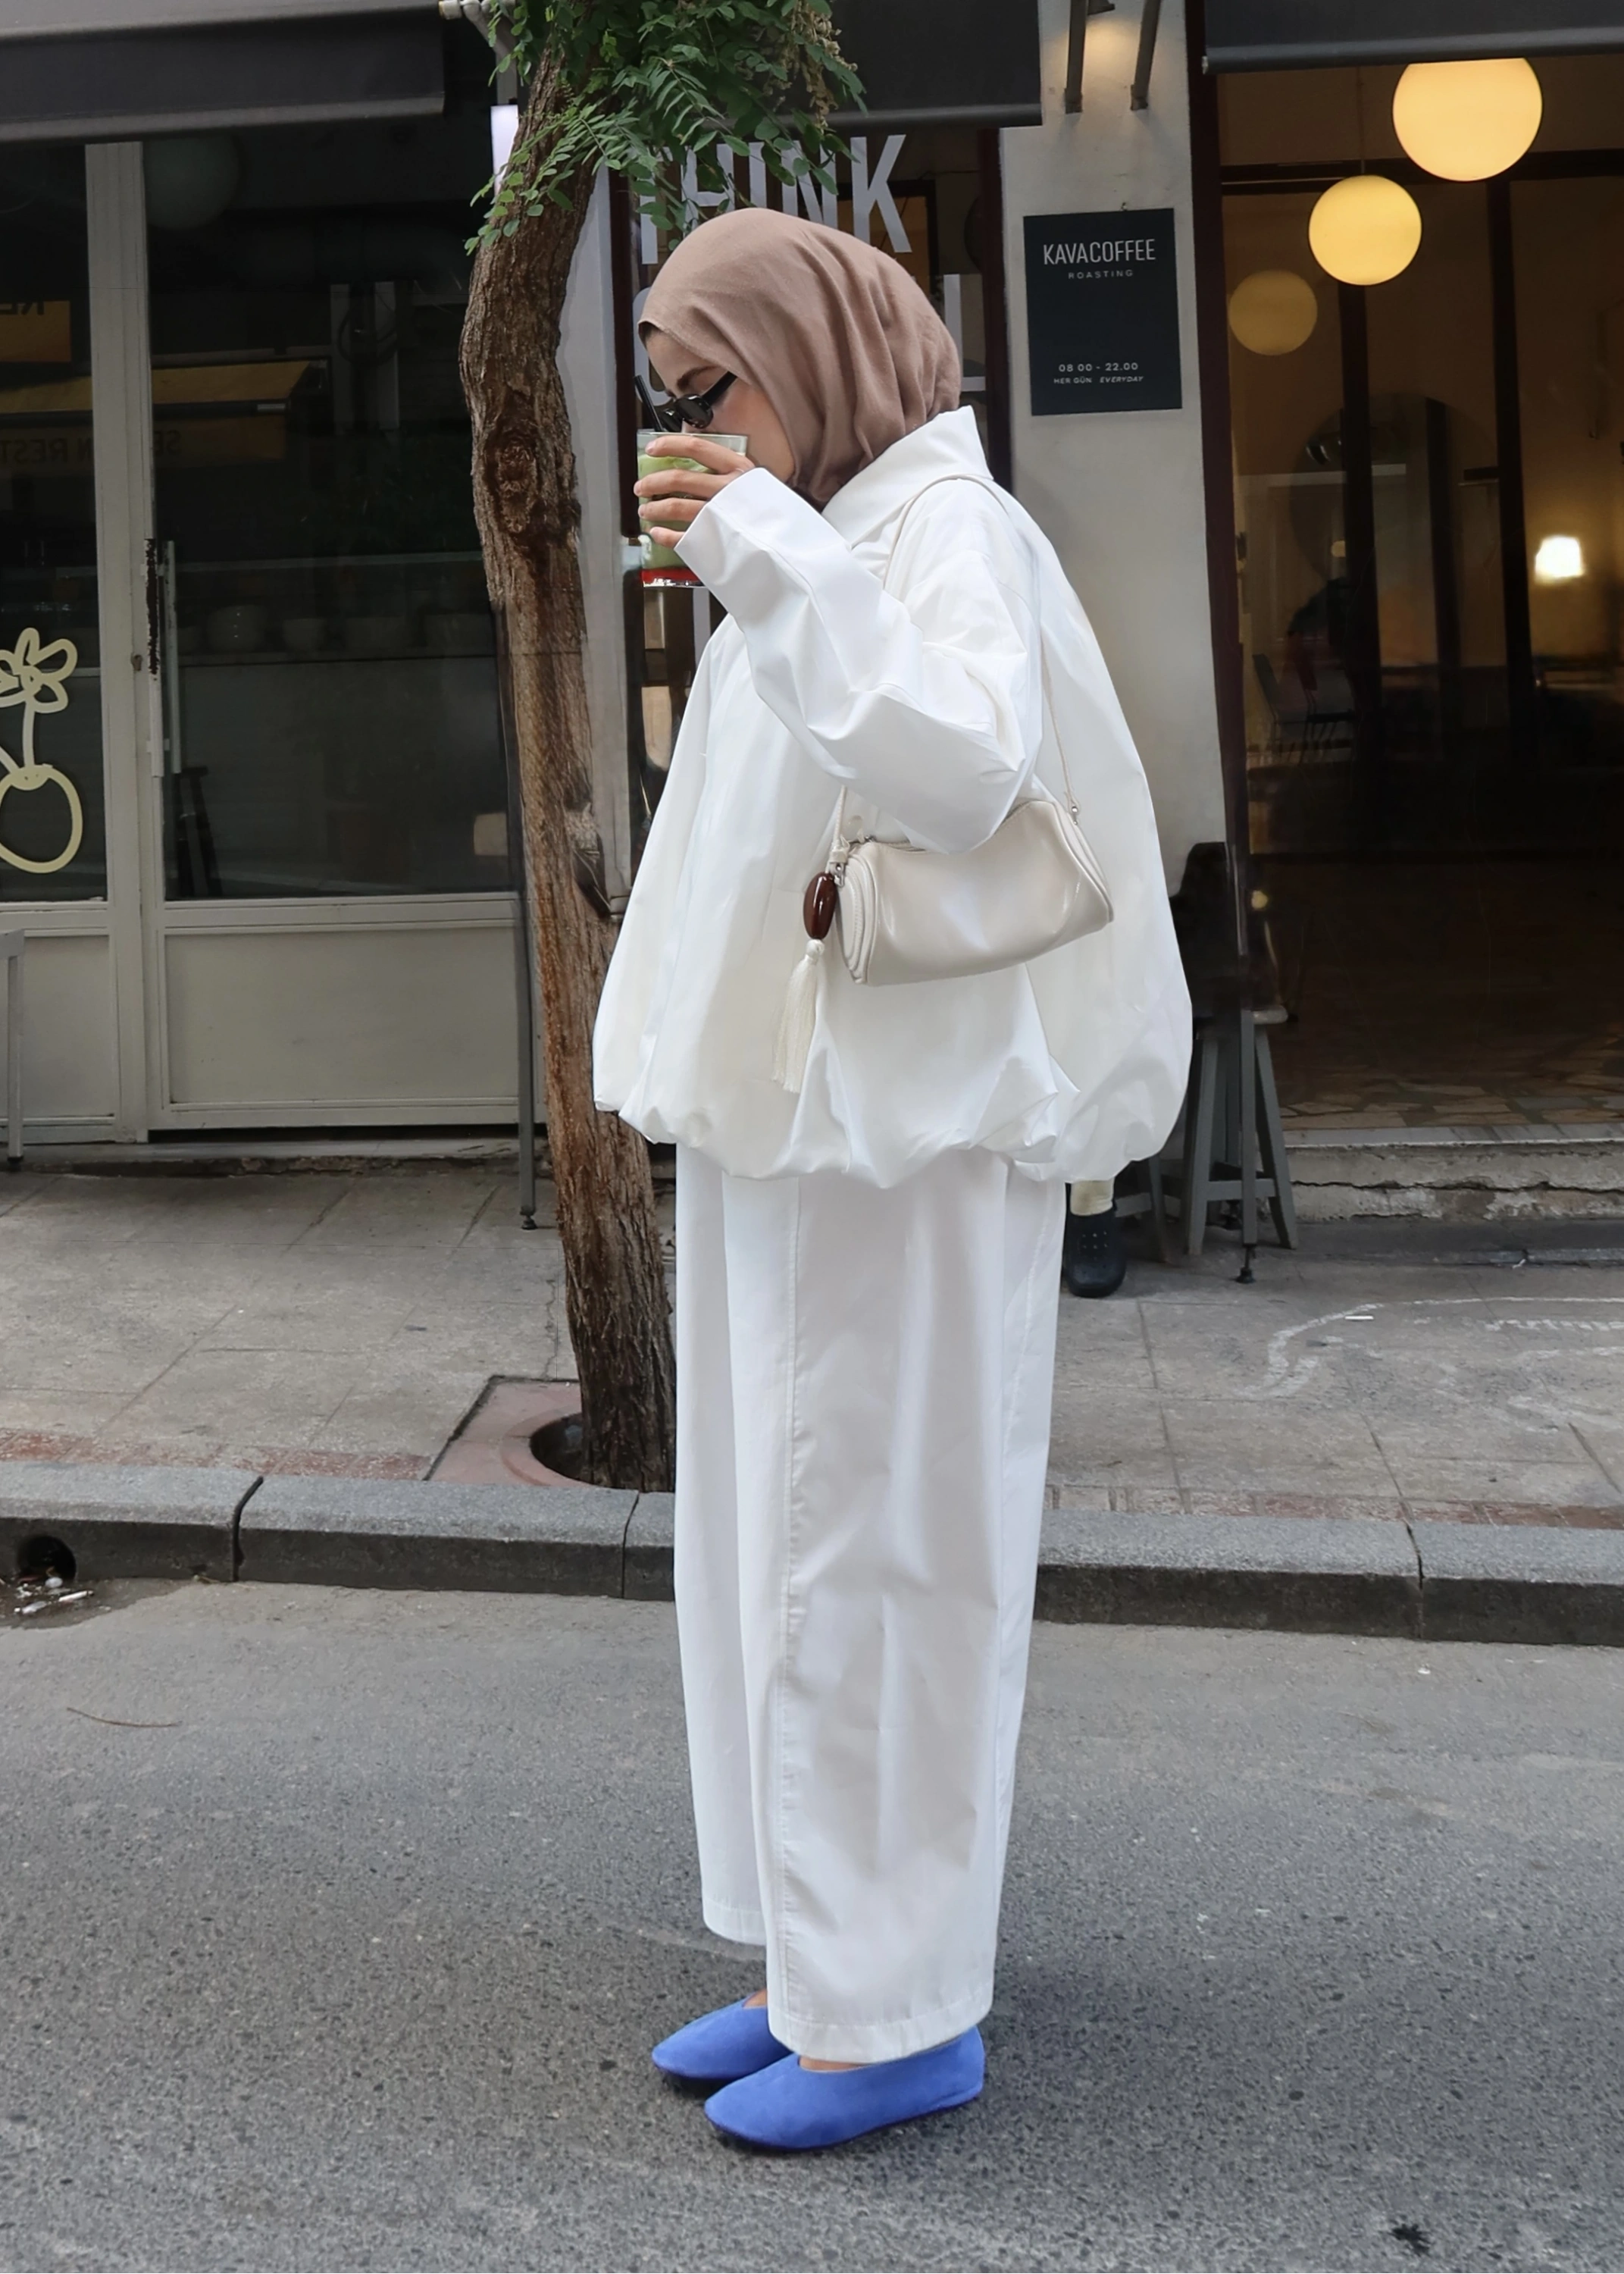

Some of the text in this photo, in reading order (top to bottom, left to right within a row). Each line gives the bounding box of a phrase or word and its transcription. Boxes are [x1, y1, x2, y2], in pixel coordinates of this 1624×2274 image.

[1043, 238, 1156, 265] KAVACOFFEE
[1068, 269, 1134, 280] ROASTING
[1105, 362, 1139, 371] 22.00
[1072, 376, 1093, 384] GÜN
[1099, 375, 1144, 384] EVERYDAY
